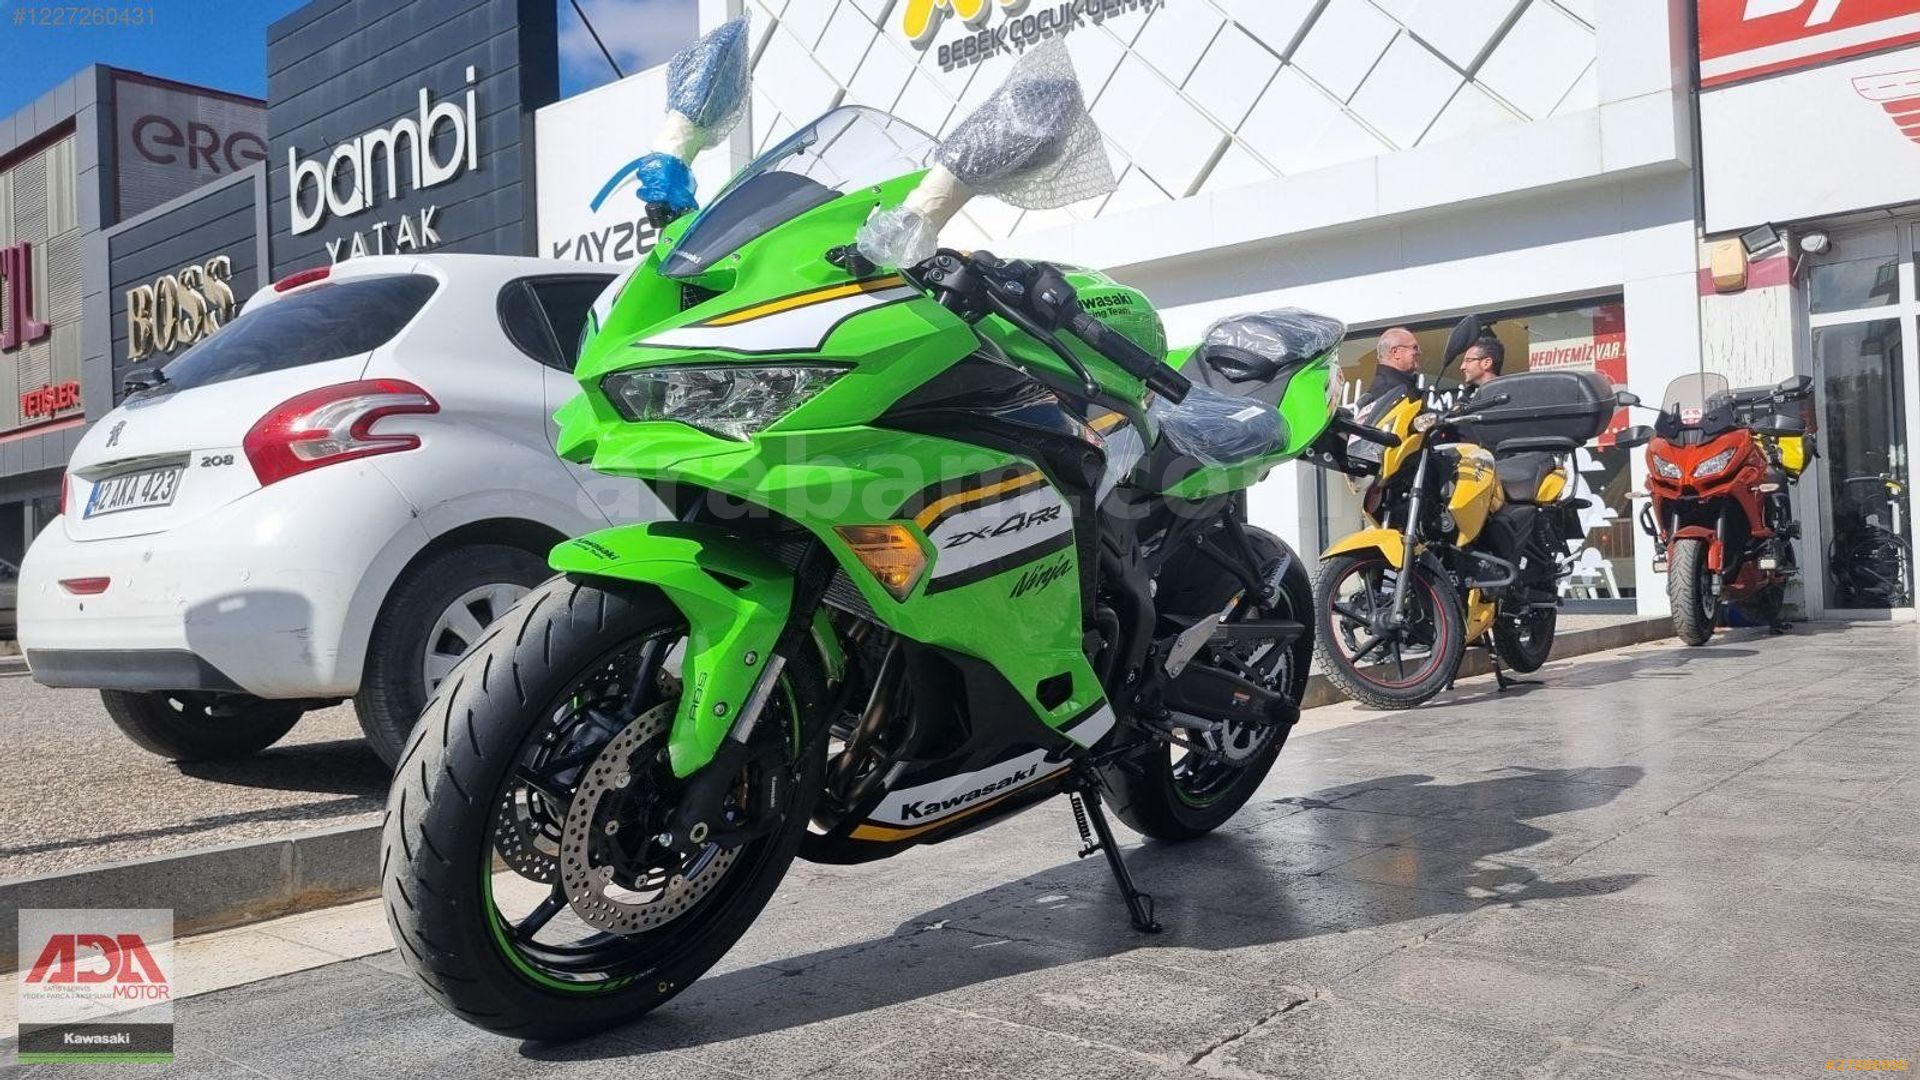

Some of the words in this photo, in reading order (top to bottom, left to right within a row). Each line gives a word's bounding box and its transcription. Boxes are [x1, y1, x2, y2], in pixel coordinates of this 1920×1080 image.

[938, 25, 1011, 66] BEBEK
[288, 65, 479, 236] bambi
[325, 205, 441, 265] YATAK
[126, 255, 236, 362] BOSS
[200, 454, 235, 468] 208
[109, 475, 140, 508] AKA
[141, 469, 177, 502] 423
[943, 504, 1062, 549] ZX-4RR
[1009, 554, 1073, 599] Ninja
[688, 671, 707, 721] ABS
[900, 763, 1039, 821] Kawasaki
